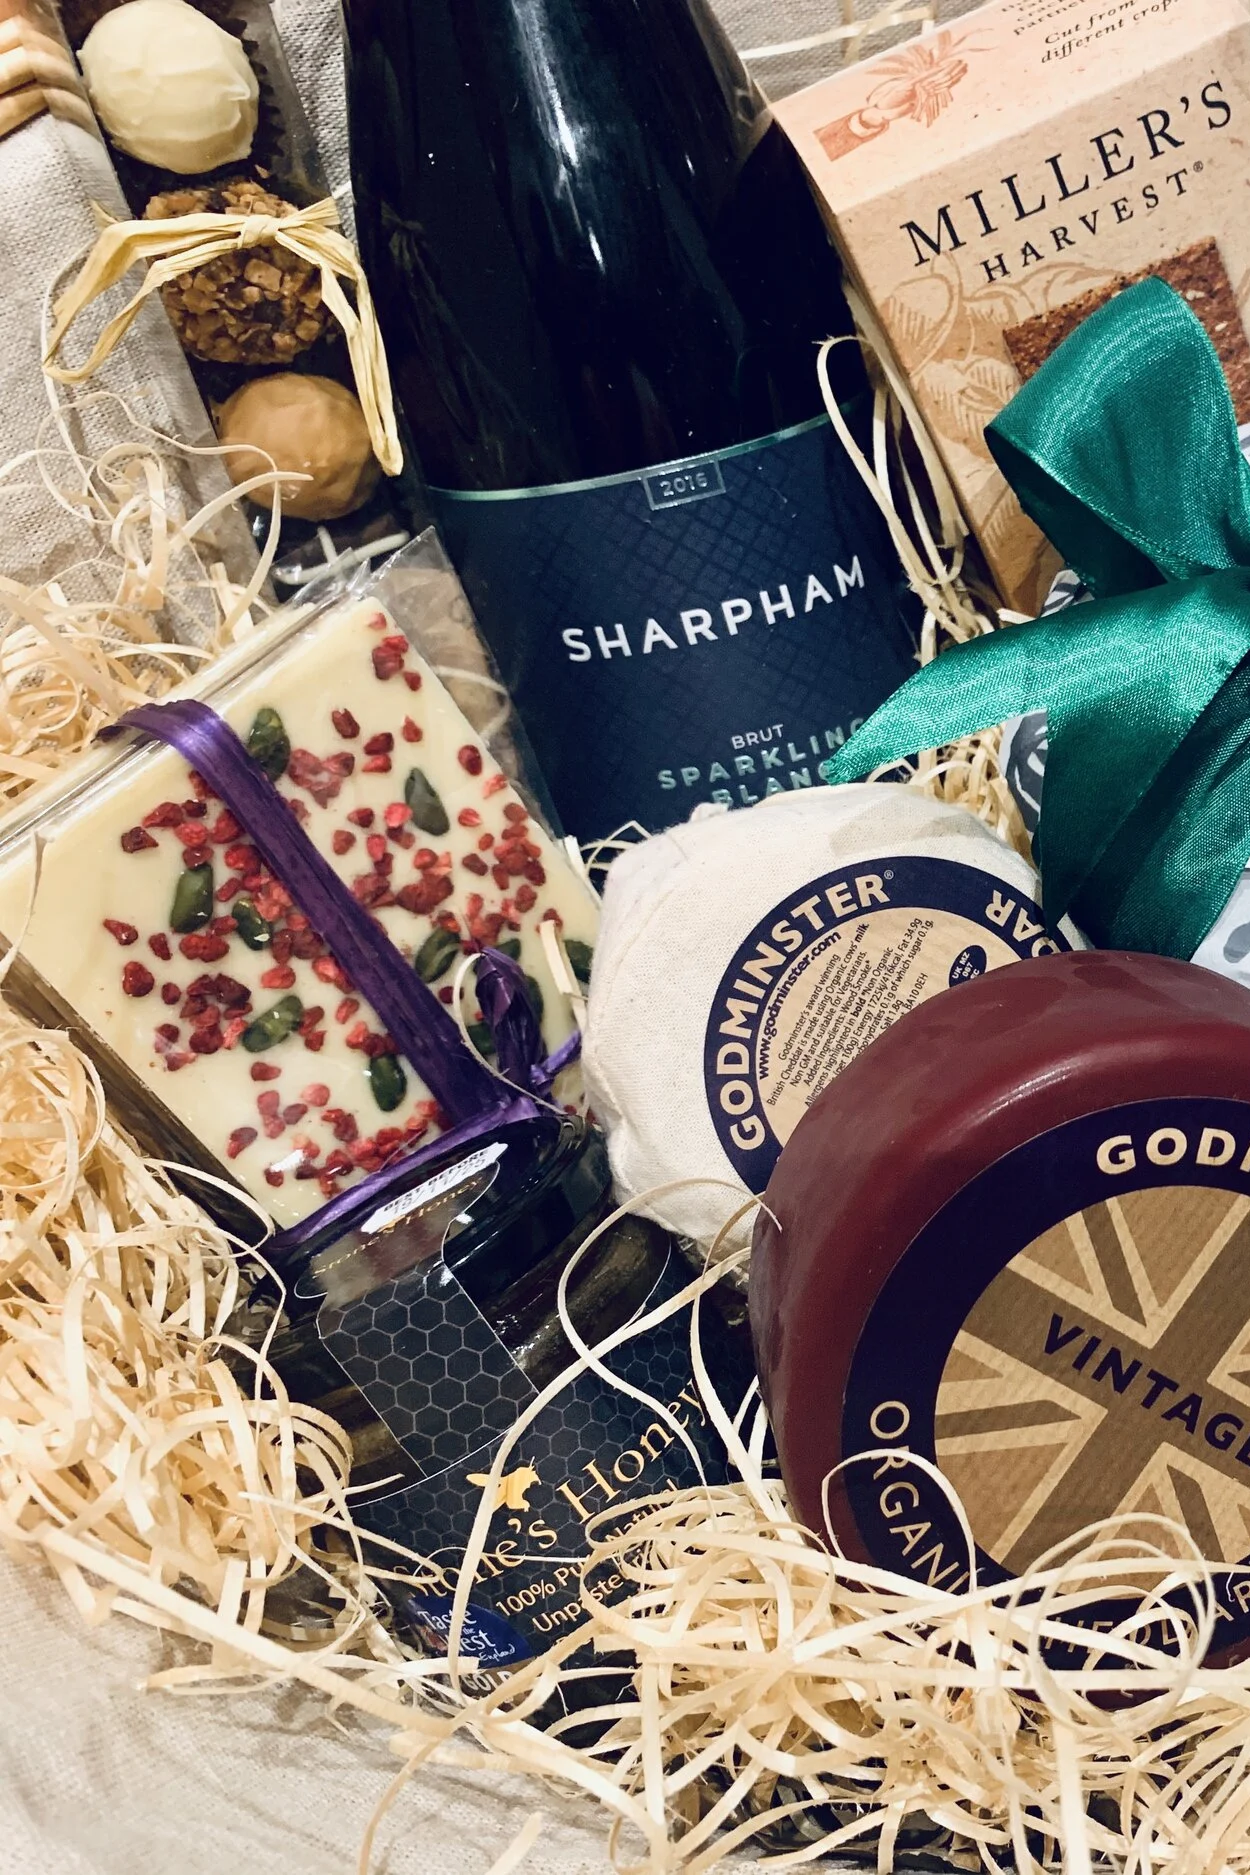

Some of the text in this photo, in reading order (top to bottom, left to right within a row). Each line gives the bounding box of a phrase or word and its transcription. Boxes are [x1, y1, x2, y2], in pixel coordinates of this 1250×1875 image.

[1041, 17, 1125, 64] different
[1044, 23, 1081, 45] Cut
[1087, 0, 1136, 31] from
[899, 80, 1232, 267] MILLER'S
[561, 555, 866, 663] SHARPHAM
[731, 723, 784, 750] BRUT
[852, 1008, 873, 1037] Energy
[896, 938, 910, 952] Fat
[890, 980, 899, 991] of
[894, 959, 911, 982] which
[907, 936, 922, 959] sugar
[952, 966, 964, 979] UK
[758, 930, 842, 1080] www.godminster.com
[765, 1080, 785, 1106] British
[780, 1046, 803, 1080] Cheddar
[802, 1016, 819, 1039] made
[814, 993, 832, 1016] using
[824, 963, 847, 994] Organic
[777, 953, 841, 1060] Godminster's award winning
[789, 1069, 804, 1087] Non
[798, 1053, 812, 1069] GM
[807, 1036, 820, 1055] and
[816, 1007, 836, 1038] suitable
[829, 995, 842, 1007] for
[802, 1058, 822, 1086] Added
[839, 988, 858, 1013] Wood
[822, 1025, 851, 1071] highlighted
[849, 996, 866, 1018] bold
[871, 946, 893, 977] Organic
[556, 1378, 707, 1524] Honey
[870, 1400, 971, 1593] ORGANI
[495, 1578, 556, 1618] 100%
